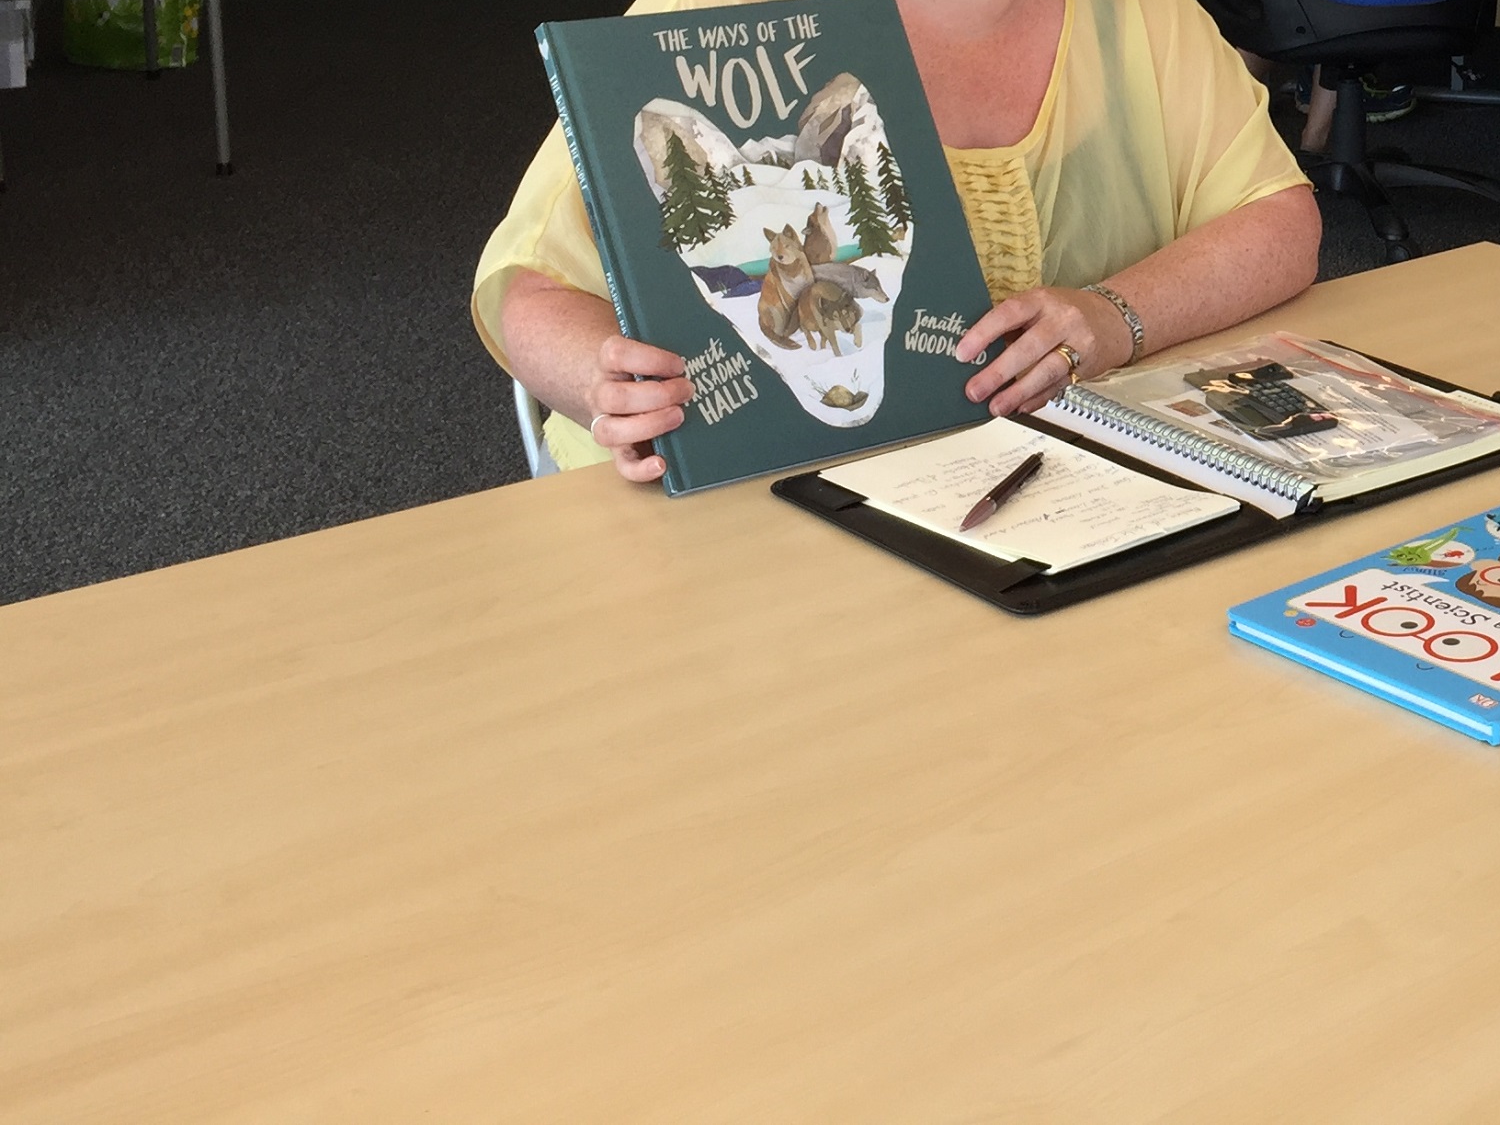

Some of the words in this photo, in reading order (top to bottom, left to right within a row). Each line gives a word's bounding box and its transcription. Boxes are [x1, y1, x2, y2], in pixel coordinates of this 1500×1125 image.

[653, 28, 693, 52] THE
[698, 23, 749, 49] WAYS
[756, 20, 779, 43] OF
[783, 13, 822, 40] THE
[675, 42, 817, 129] WOLF
[910, 308, 968, 337] Jonath
[905, 330, 987, 365] WOODWD
[684, 351, 752, 407] ASADAM-
[697, 374, 759, 426] HALLS
[1381, 580, 1491, 627] Scientist
